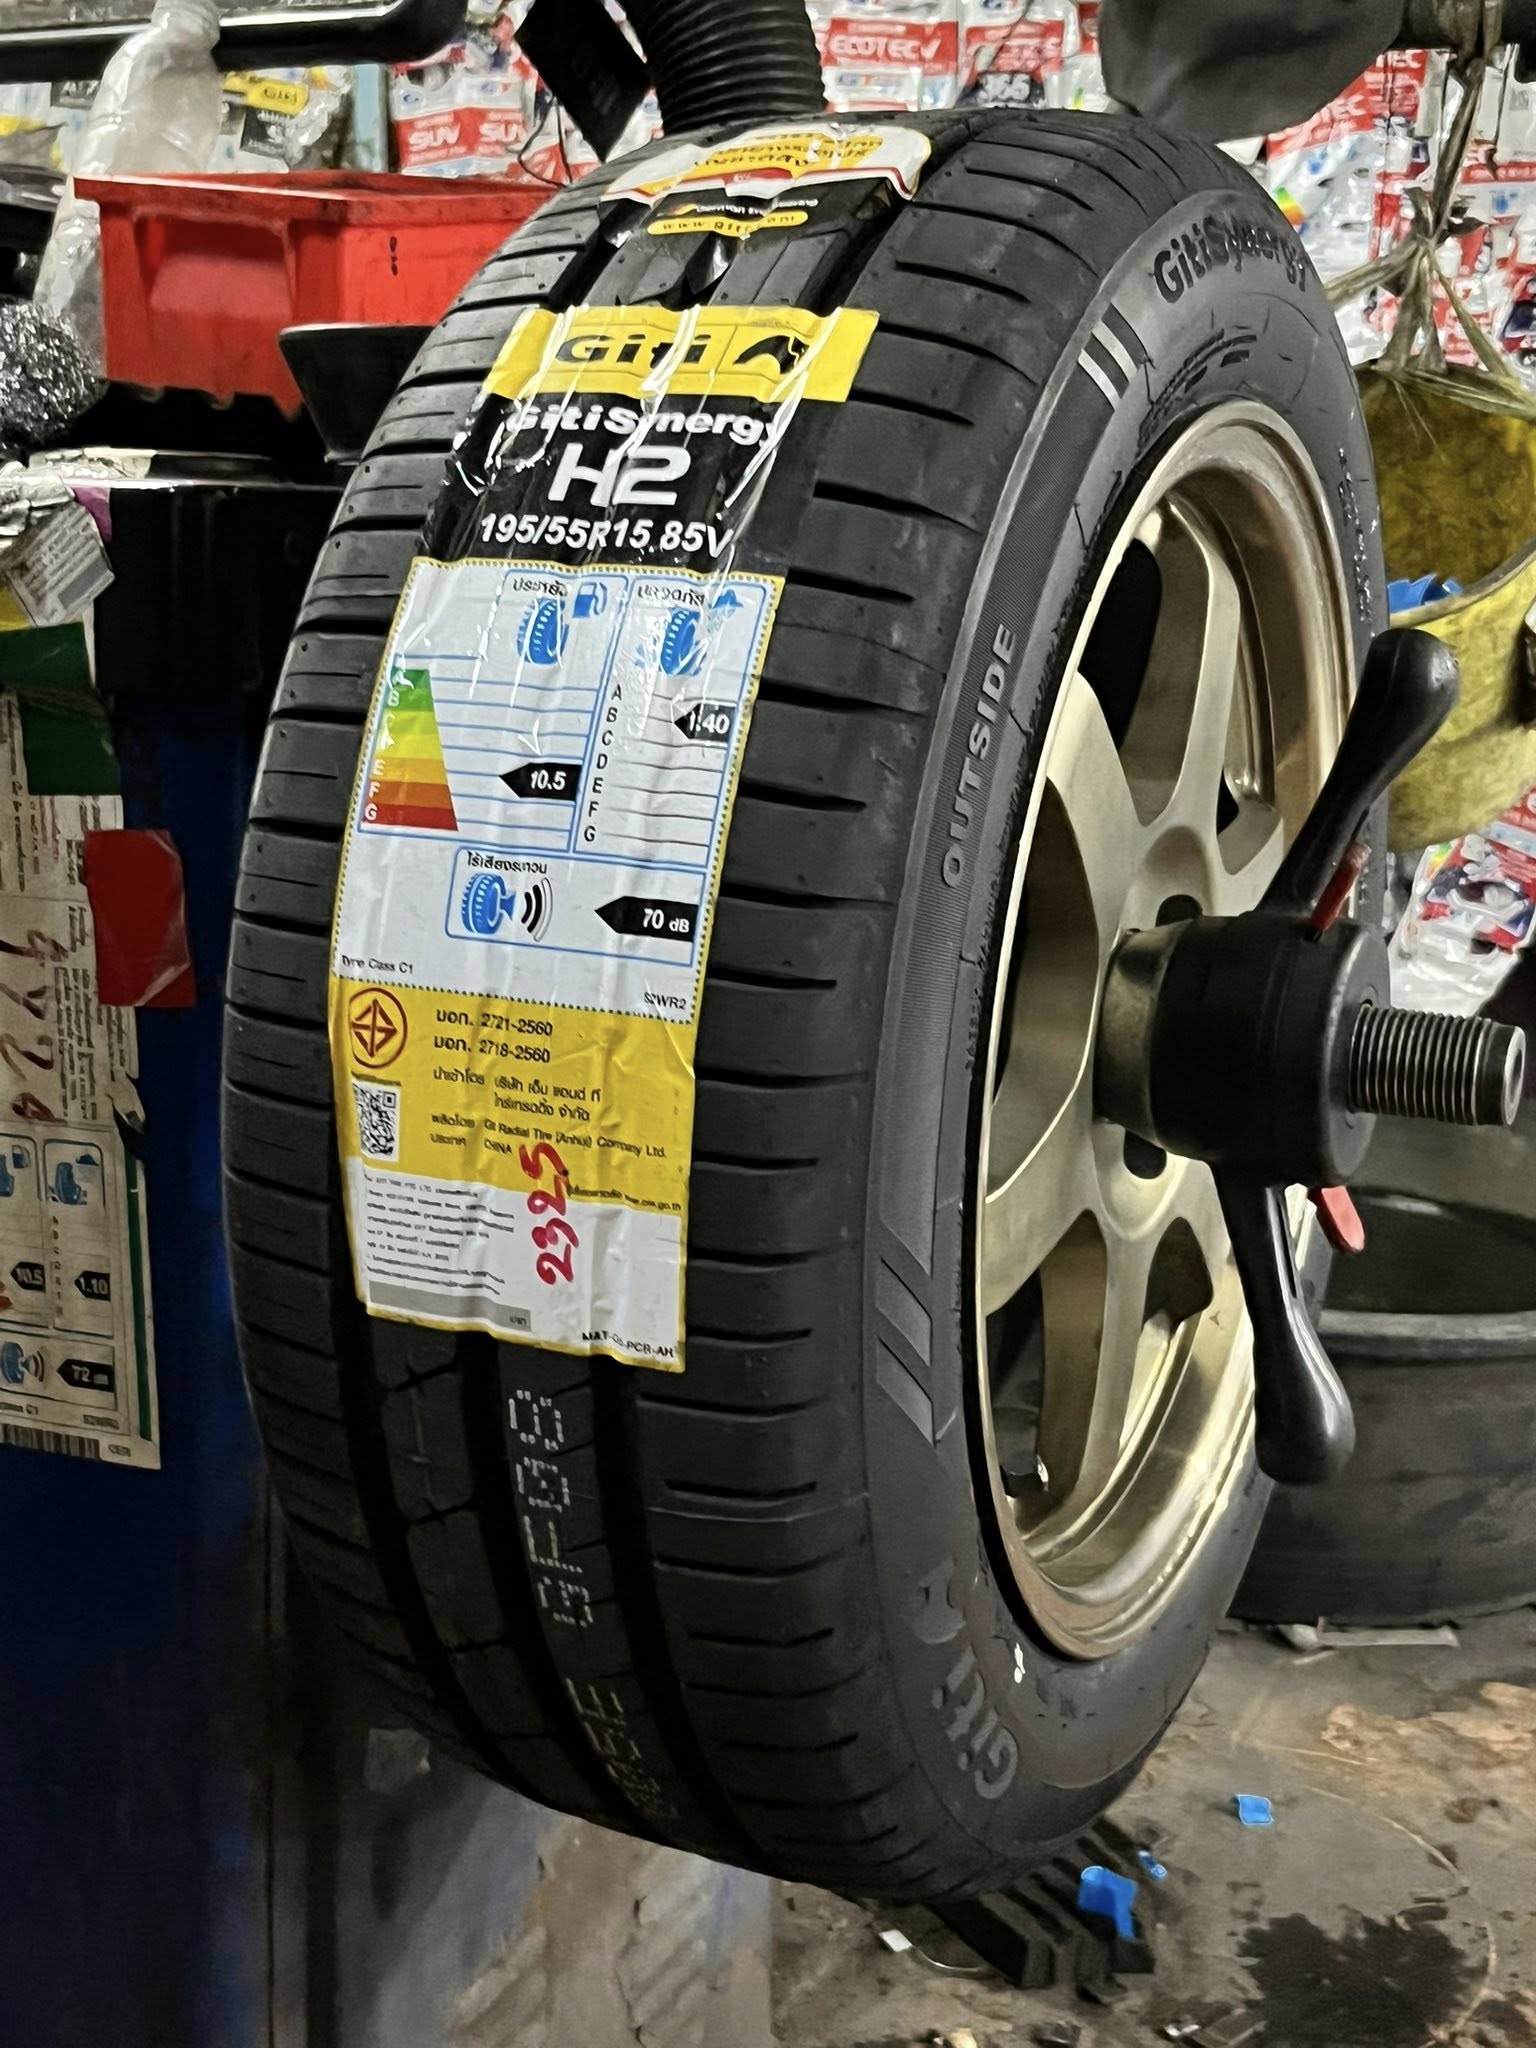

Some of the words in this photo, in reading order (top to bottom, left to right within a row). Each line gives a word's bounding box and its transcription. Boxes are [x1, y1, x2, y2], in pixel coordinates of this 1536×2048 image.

[408, 124, 461, 151] SUV
[555, 332, 713, 365] Giti
[547, 442, 692, 508] H2
[480, 512, 650, 551] 195/55R15
[659, 519, 734, 560] 85V
[611, 683, 623, 702] A
[606, 706, 618, 724] B
[601, 729, 614, 747] C
[596, 752, 608, 770] D
[942, 622, 1016, 889] OUTSIDE
[373, 759, 386, 777] E
[530, 768, 568, 791] 10.5
[592, 776, 604, 795] E
[368, 782, 381, 800] F
[364, 803, 378, 822] G
[588, 800, 600, 818] F
[583, 825, 597, 843] G
[642, 908, 665, 930] 70
[668, 917, 690, 933] dB
[398, 961, 414, 975] C1
[518, 1141, 581, 1286] 2325
